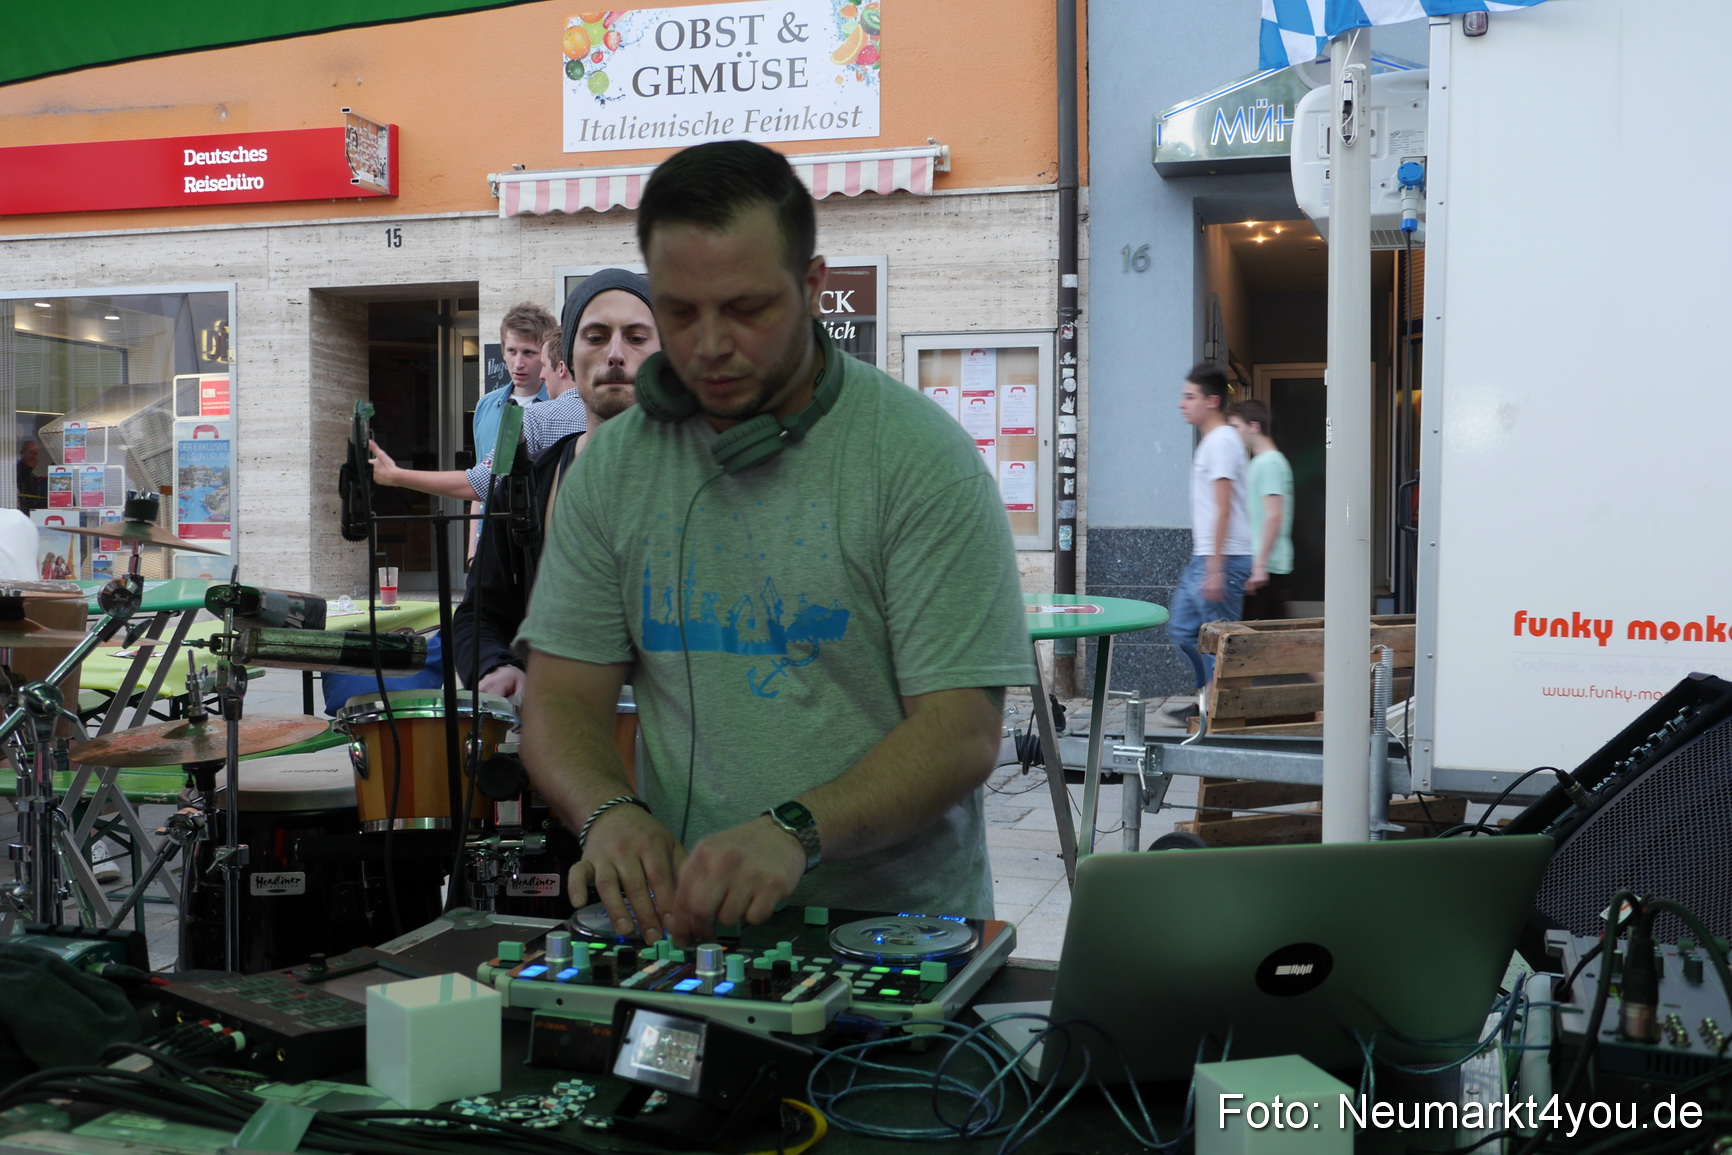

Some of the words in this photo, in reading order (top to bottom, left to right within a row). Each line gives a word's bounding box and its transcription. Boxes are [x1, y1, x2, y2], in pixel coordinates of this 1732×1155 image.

[655, 14, 765, 52] OBST
[777, 11, 809, 44] &
[632, 51, 809, 98] GEMÜSE
[578, 110, 734, 142] Italienische
[742, 105, 863, 134] Feinkost
[1210, 98, 1297, 146] MÜH
[183, 146, 268, 166] Deutsches
[183, 173, 264, 193] Reisebüro
[385, 228, 402, 248] 15
[1121, 243, 1151, 273] 16
[818, 290, 856, 314] CK
[1514, 610, 1613, 647] funky
[1627, 615, 1732, 642] monk
[1542, 685, 1665, 703] www.funky-mo
[255, 875, 301, 890] Headliner
